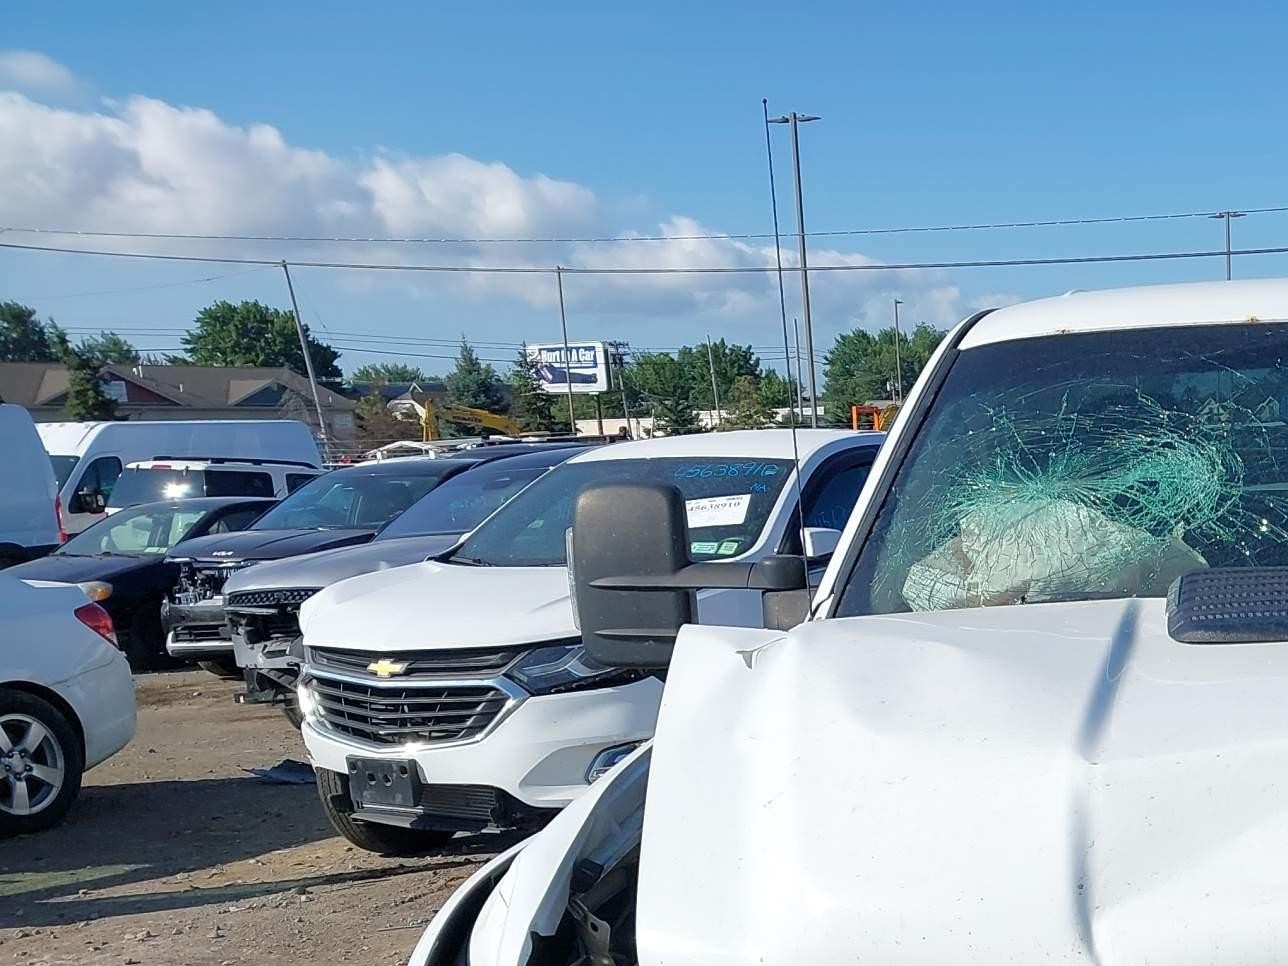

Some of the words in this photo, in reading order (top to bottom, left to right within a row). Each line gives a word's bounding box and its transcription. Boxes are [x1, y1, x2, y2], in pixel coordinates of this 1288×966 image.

[541, 349, 560, 362] Hurt
[571, 348, 579, 361] A
[579, 347, 595, 361] Car
